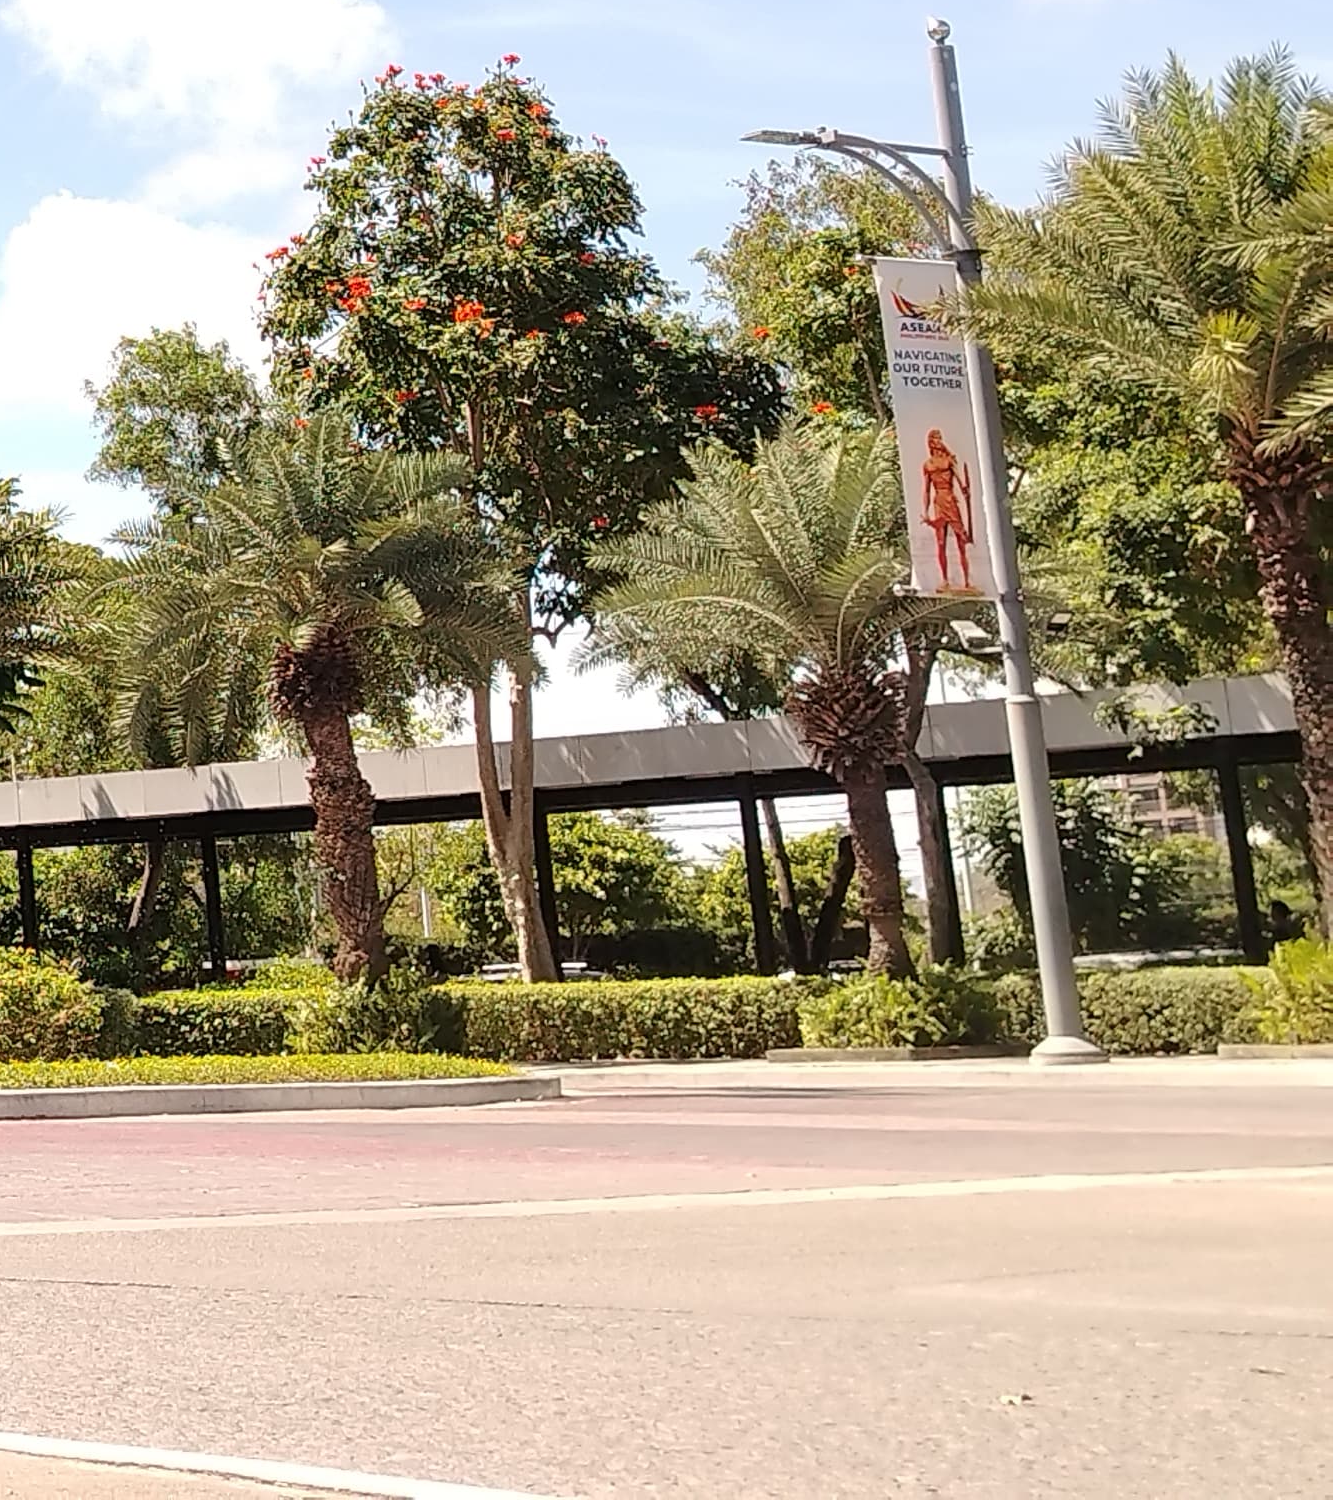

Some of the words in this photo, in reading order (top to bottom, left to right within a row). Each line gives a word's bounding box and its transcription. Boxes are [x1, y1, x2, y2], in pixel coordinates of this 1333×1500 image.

[894, 349, 962, 363] NAVIGATING
[893, 363, 920, 374] OUR
[924, 365, 964, 377] FUTURE
[902, 376, 963, 390] TOGETHER
